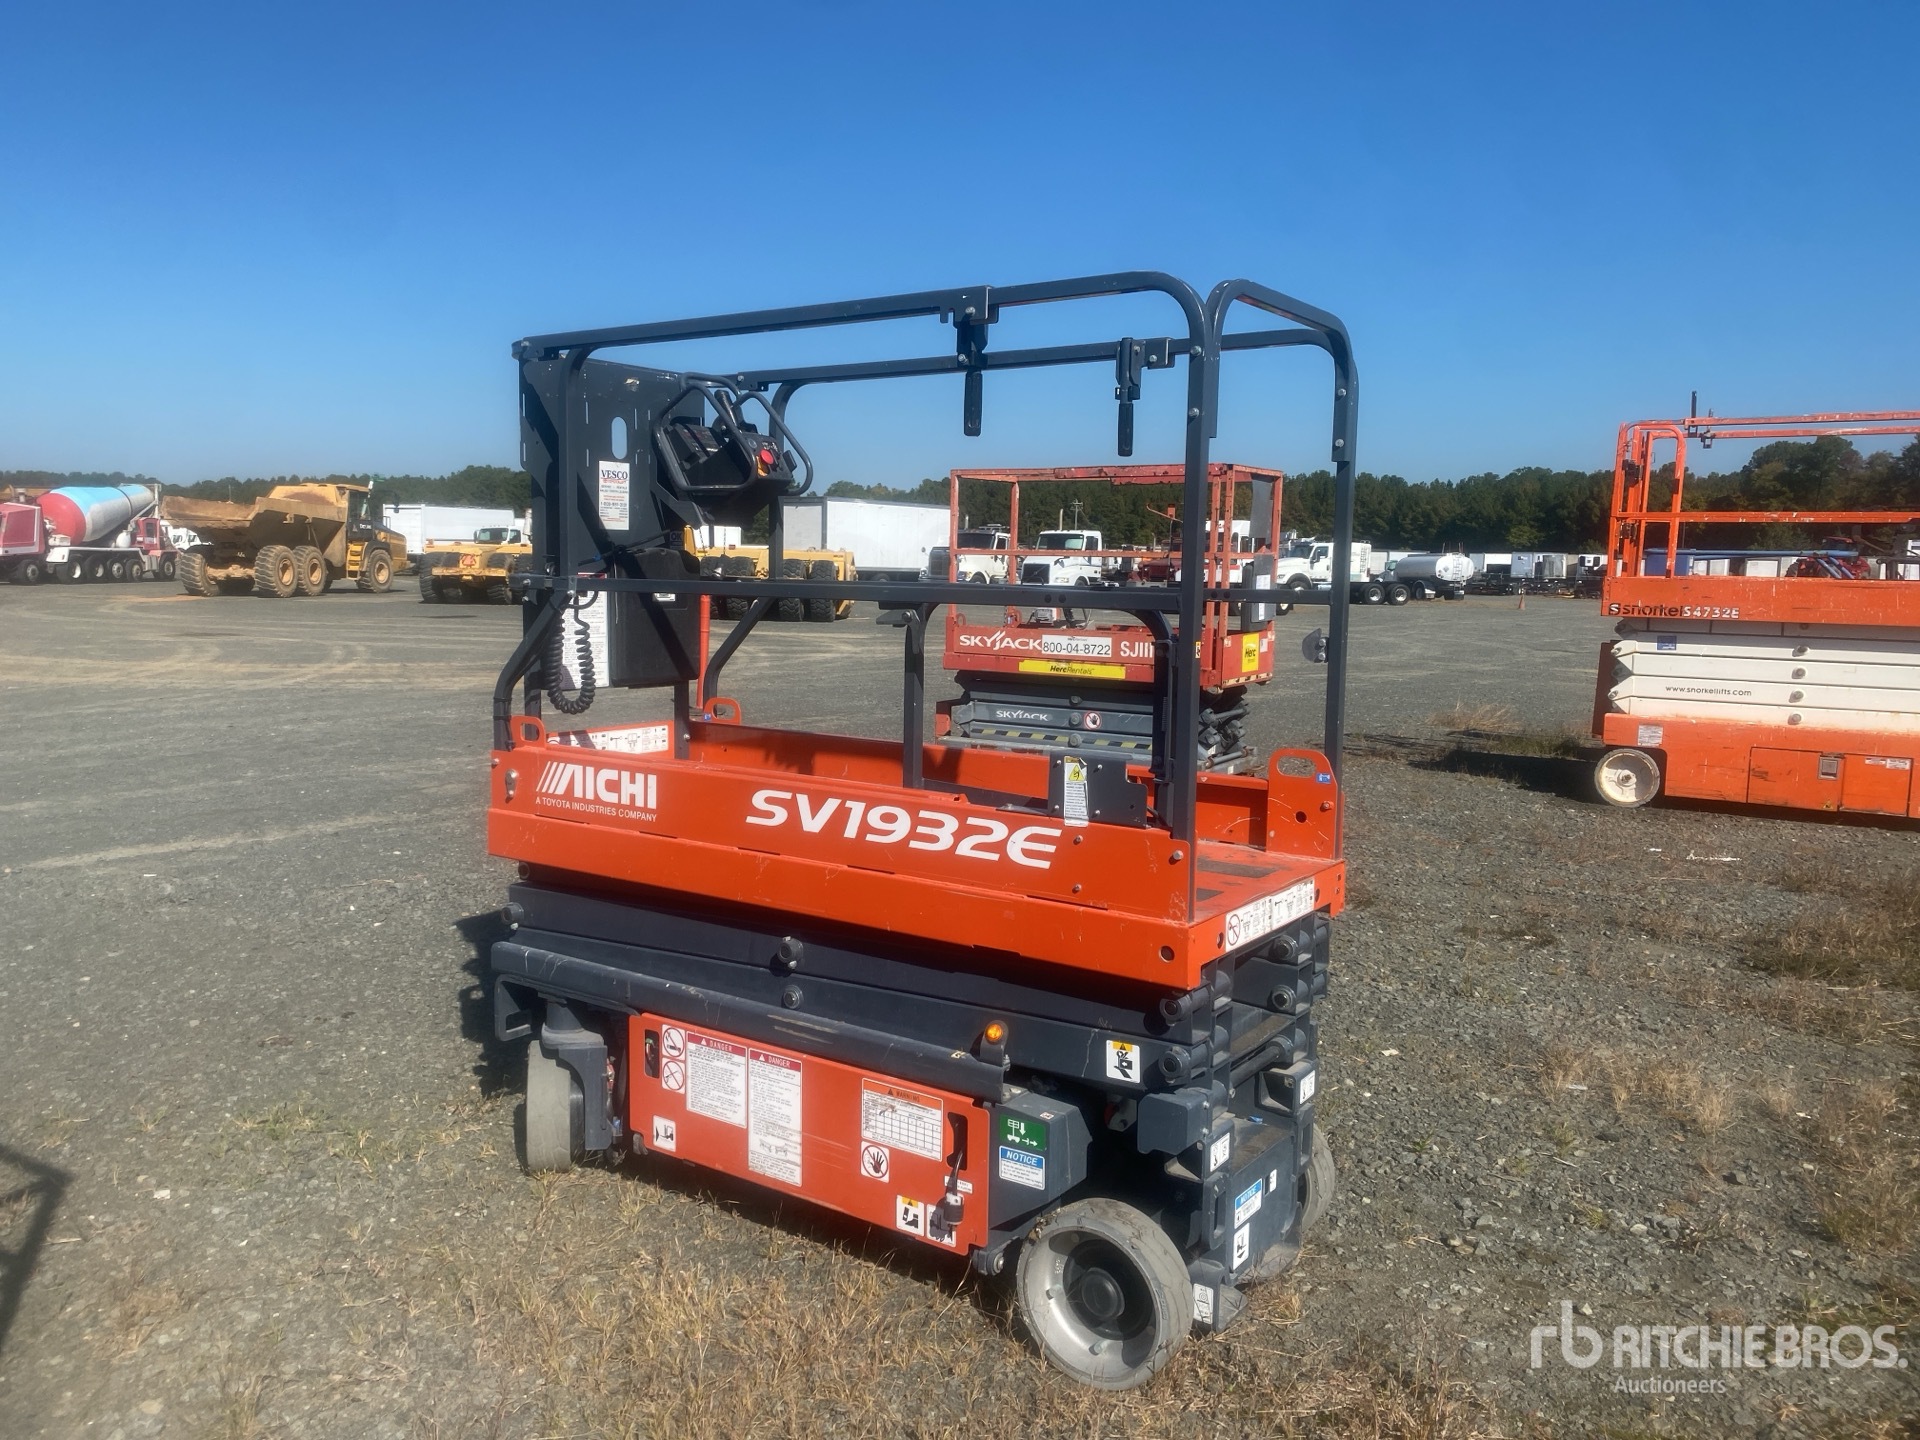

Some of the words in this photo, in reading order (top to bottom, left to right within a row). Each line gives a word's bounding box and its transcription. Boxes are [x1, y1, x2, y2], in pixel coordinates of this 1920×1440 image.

[601, 470, 628, 479] VESCO
[959, 631, 1042, 650] SKYJACK
[1043, 642, 1111, 656] 800-04-8722
[1665, 686, 1752, 696] www.snorkellifts.com
[536, 761, 658, 809] AICHI
[543, 798, 571, 809] TOYOTA
[572, 802, 617, 816] INDUSTRIES
[618, 808, 657, 822] COMPANY
[745, 789, 1063, 870] SV1932E
[709, 1040, 733, 1052] DANGER
[768, 1055, 791, 1069] DANGER
[1006, 1150, 1038, 1166] NOTICE
